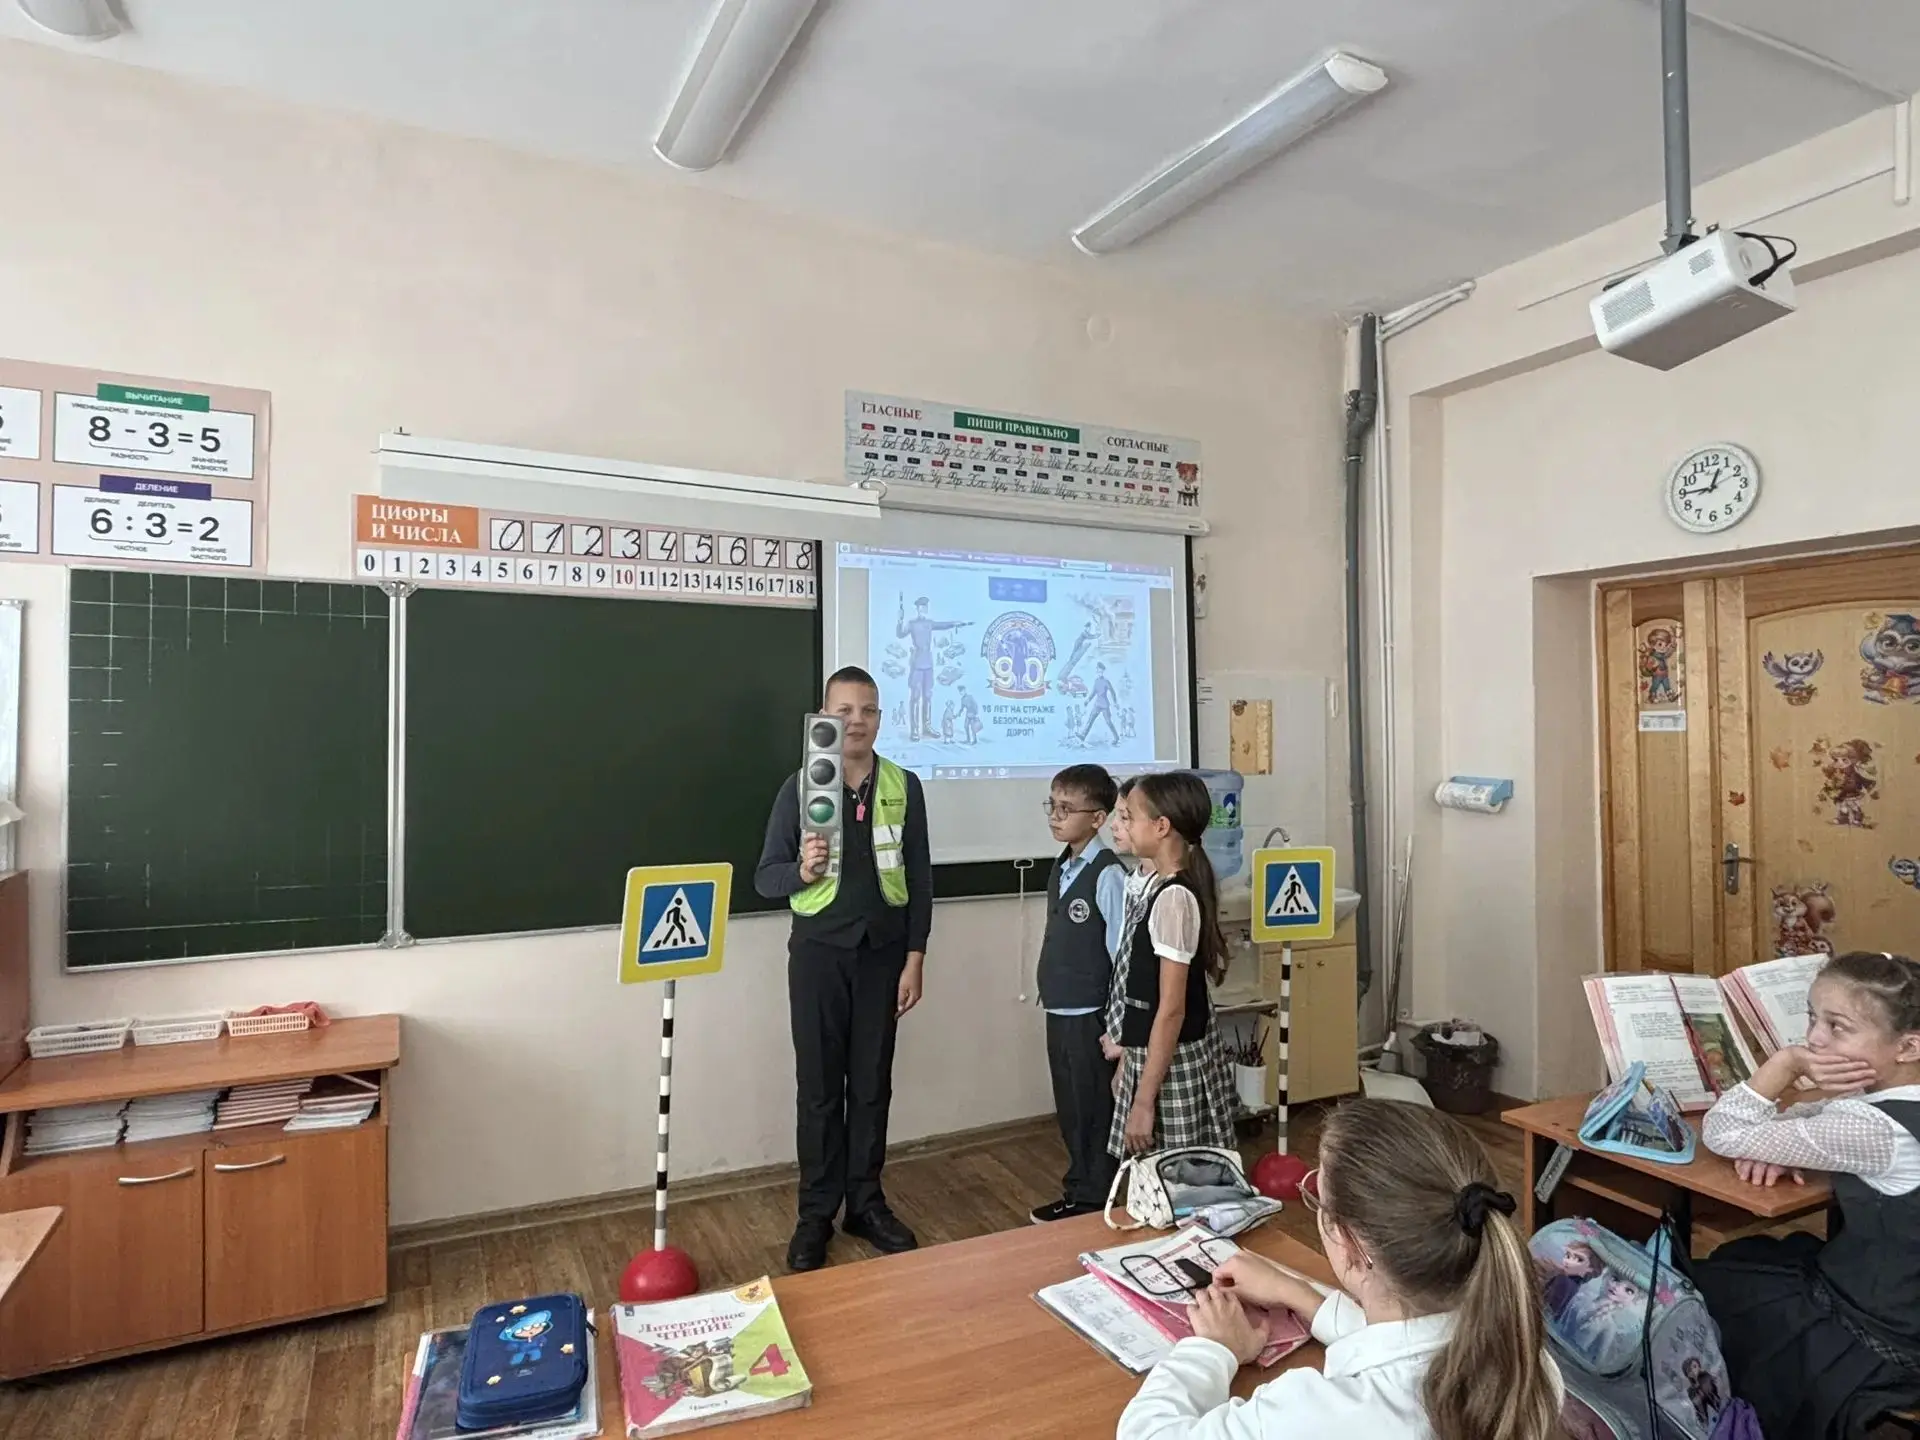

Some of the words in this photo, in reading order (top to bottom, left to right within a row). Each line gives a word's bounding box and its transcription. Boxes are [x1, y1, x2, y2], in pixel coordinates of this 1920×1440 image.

[125, 391, 183, 405] ВЫЧИТАНИЕ
[862, 402, 922, 420] ГЛАСНЫЕ
[89, 416, 111, 442] 8
[148, 422, 169, 448] 3
[200, 427, 220, 453] 5
[967, 416, 1001, 430] ПИШИ
[1005, 422, 1068, 440] ПРАВИЛЬНО
[1107, 436, 1169, 453] СОГЛАСНЫЕ
[1705, 454, 1719, 467] 12
[1724, 456, 1730, 467] 1
[1693, 462, 1705, 473] 11
[1733, 465, 1741, 477] 2
[1683, 474, 1696, 486] 10
[1740, 477, 1748, 488] 3
[134, 482, 178, 493] ДЕЛЕНИЕ
[1679, 488, 1686, 499] 9
[1734, 490, 1742, 502] 4
[1684, 500, 1692, 510] 8
[1724, 503, 1732, 515] 5
[371, 503, 448, 523] ЦИФРЫ
[1695, 508, 1702, 520] 7
[1709, 510, 1717, 521] 6
[91, 508, 112, 534] 6
[146, 512, 167, 538] 3
[199, 516, 219, 542] 2
[372, 524, 385, 538] И
[392, 527, 462, 544] ЧИСЛА
[499, 520, 524, 550] 0
[546, 523, 564, 553] 1
[584, 526, 603, 556] 2
[622, 529, 641, 559] 3
[660, 531, 677, 561] 4
[695, 534, 712, 563] 5
[730, 537, 747, 565] 6
[765, 539, 780, 567] 7
[796, 542, 812, 569] 8
[364, 554, 375, 571] 0
[394, 556, 401, 572] 1
[419, 558, 429, 573] 2
[446, 560, 456, 575] 3
[472, 561, 481, 576] 4
[498, 562, 508, 577] 5
[523, 564, 532, 579] 6
[548, 565, 557, 580] 7
[572, 566, 582, 581] 8
[596, 568, 605, 583] 9
[616, 570, 633, 584] 10
[640, 571, 654, 586] 11
[662, 572, 677, 587] 12
[684, 574, 700, 588] 13
[706, 574, 721, 589] 14
[727, 576, 743, 590] 15
[748, 577, 763, 591] 16
[768, 578, 783, 592] 17
[789, 580, 804, 594] 18
[808, 581, 814, 594] 1
[992, 716, 1045, 724] БЕЗОПАСНЫХ
[639, 1312, 745, 1333] Литературное
[656, 1322, 732, 1340] ЧТЕНИЕ
[750, 1344, 791, 1377] 4
